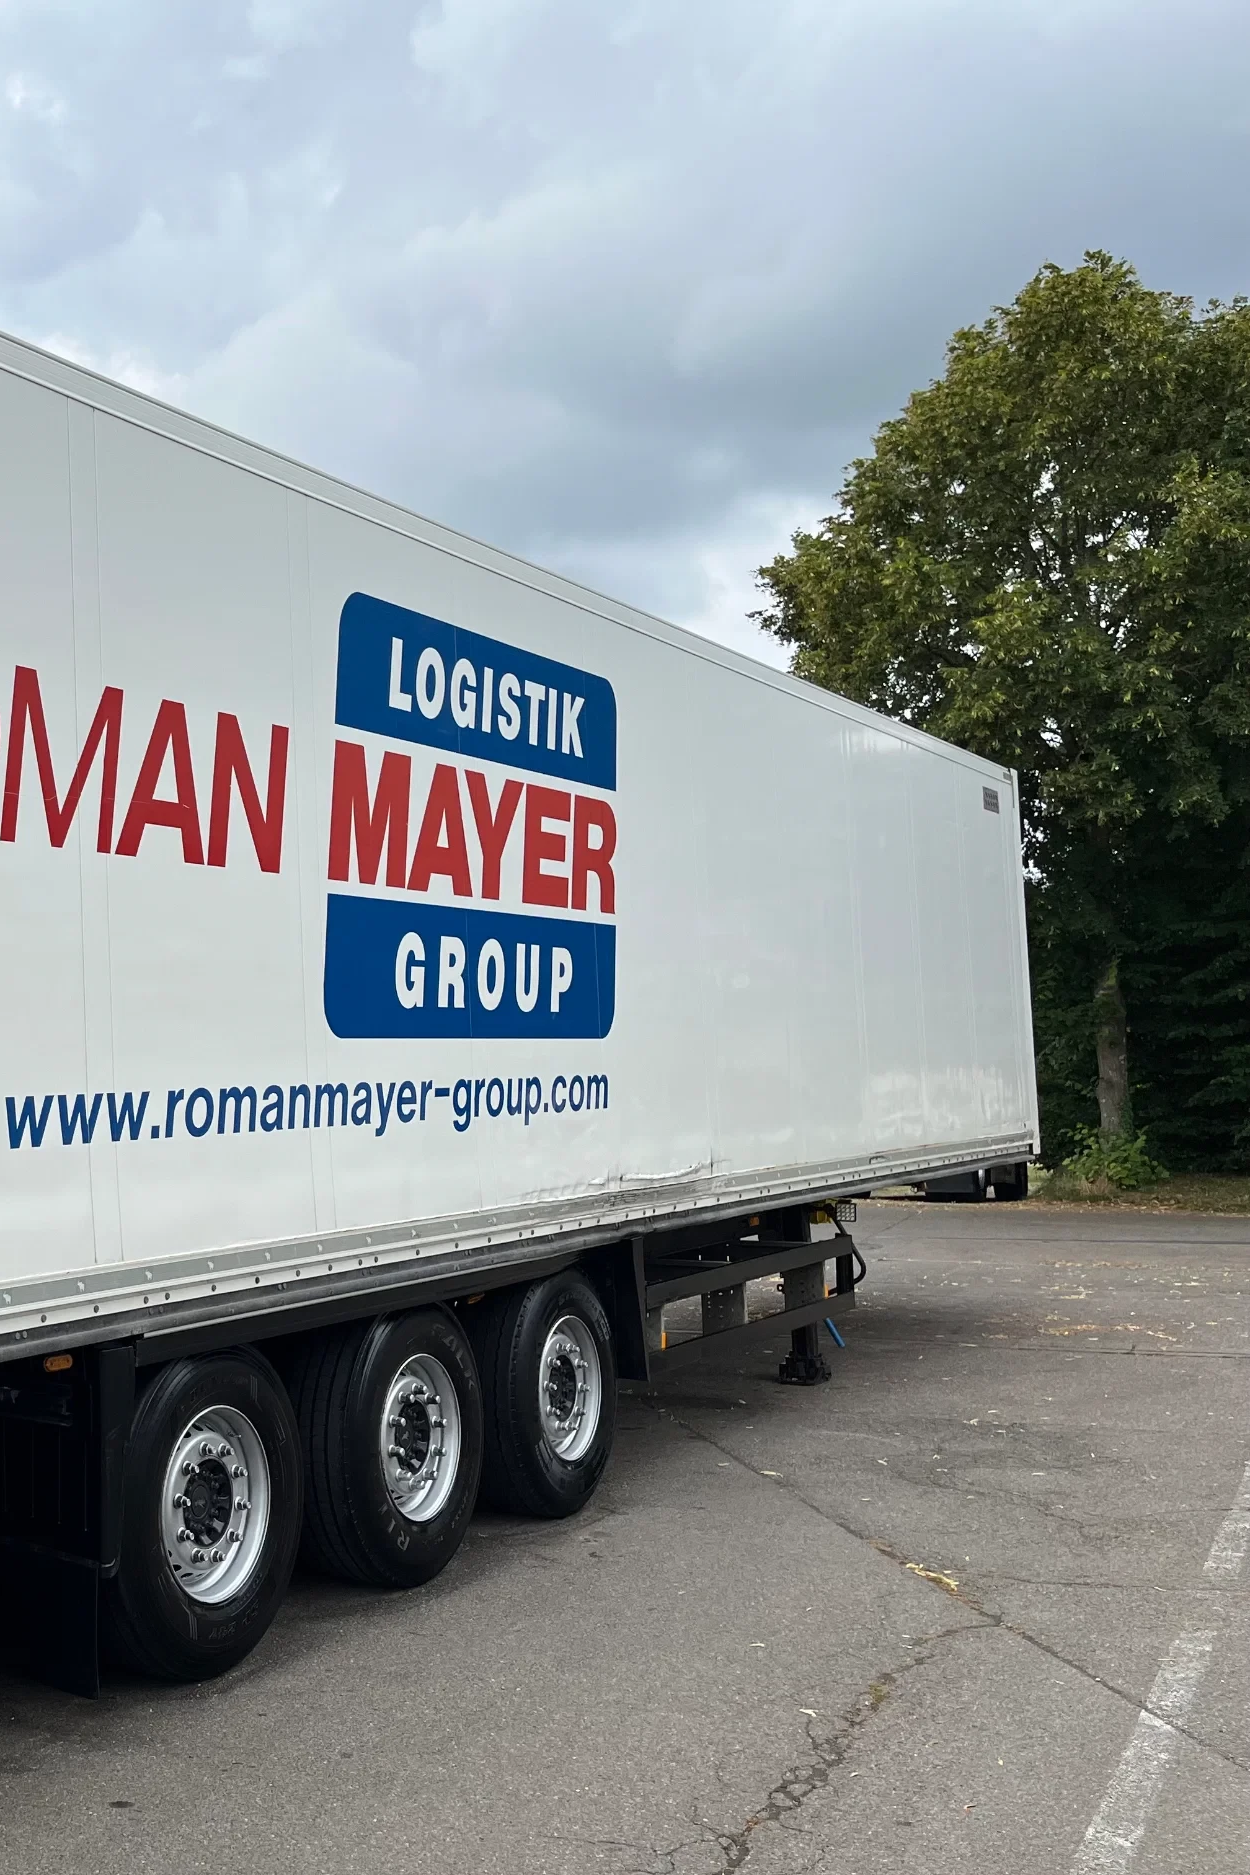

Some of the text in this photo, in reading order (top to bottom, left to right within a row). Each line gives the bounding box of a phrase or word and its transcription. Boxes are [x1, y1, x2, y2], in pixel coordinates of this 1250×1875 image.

[389, 637, 585, 758] LOGISTIK
[328, 740, 617, 914] MAYER
[395, 931, 573, 1014] GROUP
[5, 1074, 609, 1149] www.romanmayer-group.com
